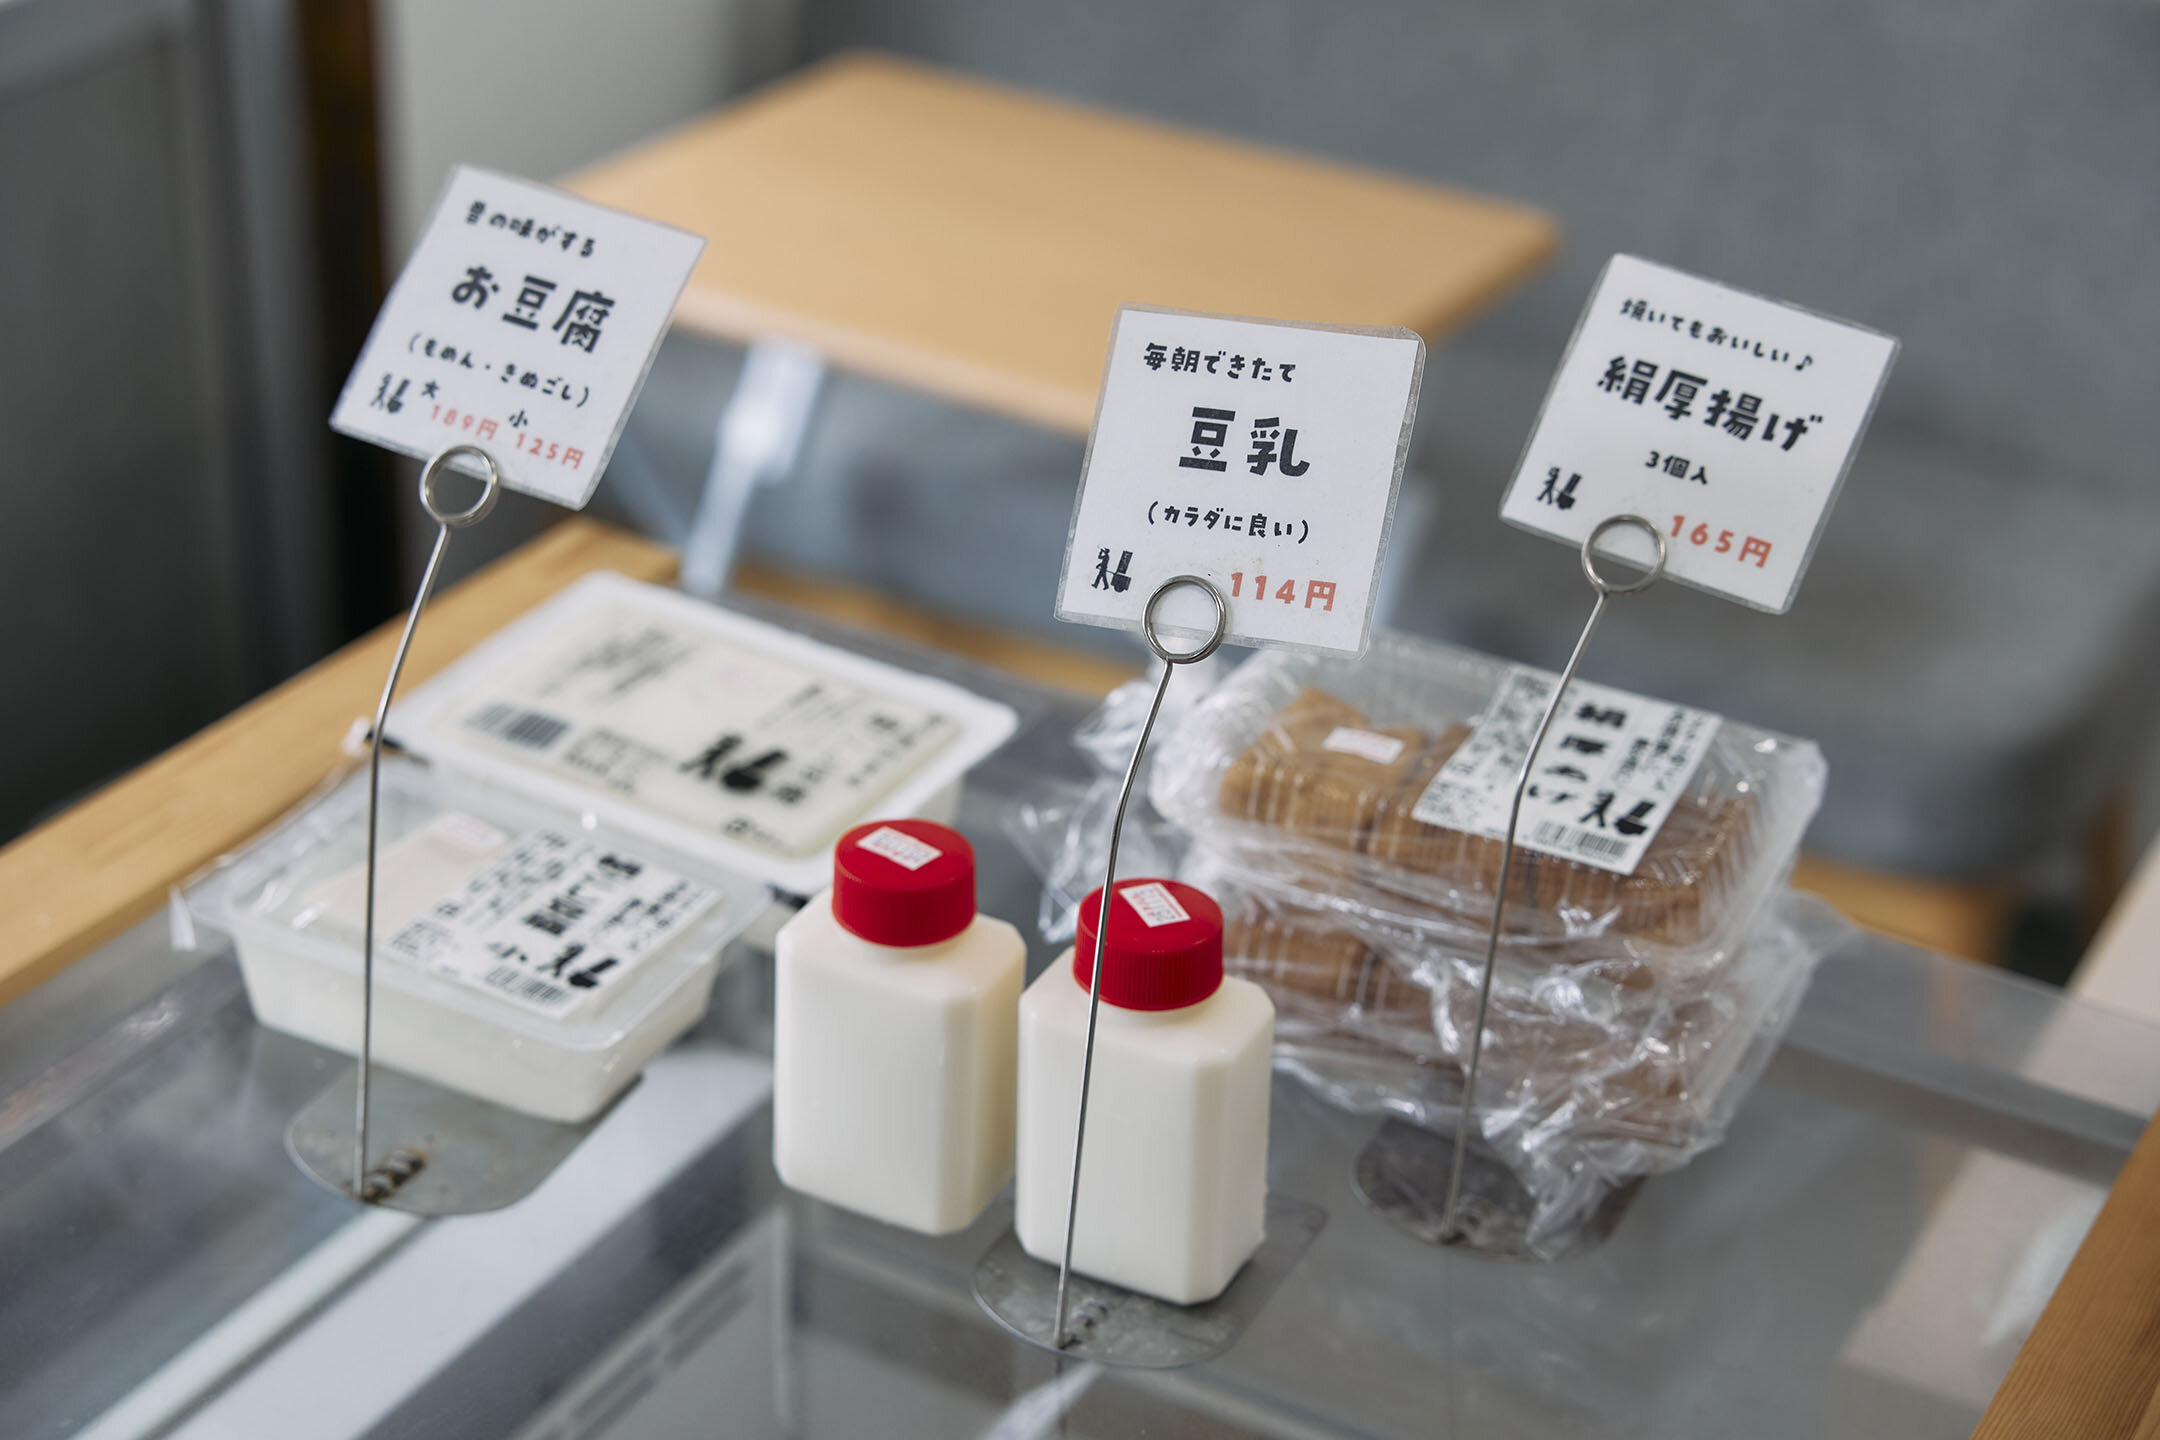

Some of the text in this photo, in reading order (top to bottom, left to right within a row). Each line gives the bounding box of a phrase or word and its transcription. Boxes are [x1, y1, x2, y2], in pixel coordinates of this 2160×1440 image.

[450, 265, 616, 354] お豆腐
[1143, 341, 1297, 384] 毎朝できたて
[421, 379, 529, 429] 大 小
[1596, 355, 1824, 453] 絹厚揚げ
[430, 403, 585, 470] 189円 125円
[1178, 406, 1311, 477] 豆乳
[1644, 450, 1709, 486] 3個入
[1147, 500, 1310, 545] （カラダに良い）
[1670, 514, 1774, 569] 165円
[1230, 571, 1338, 611] 114円
